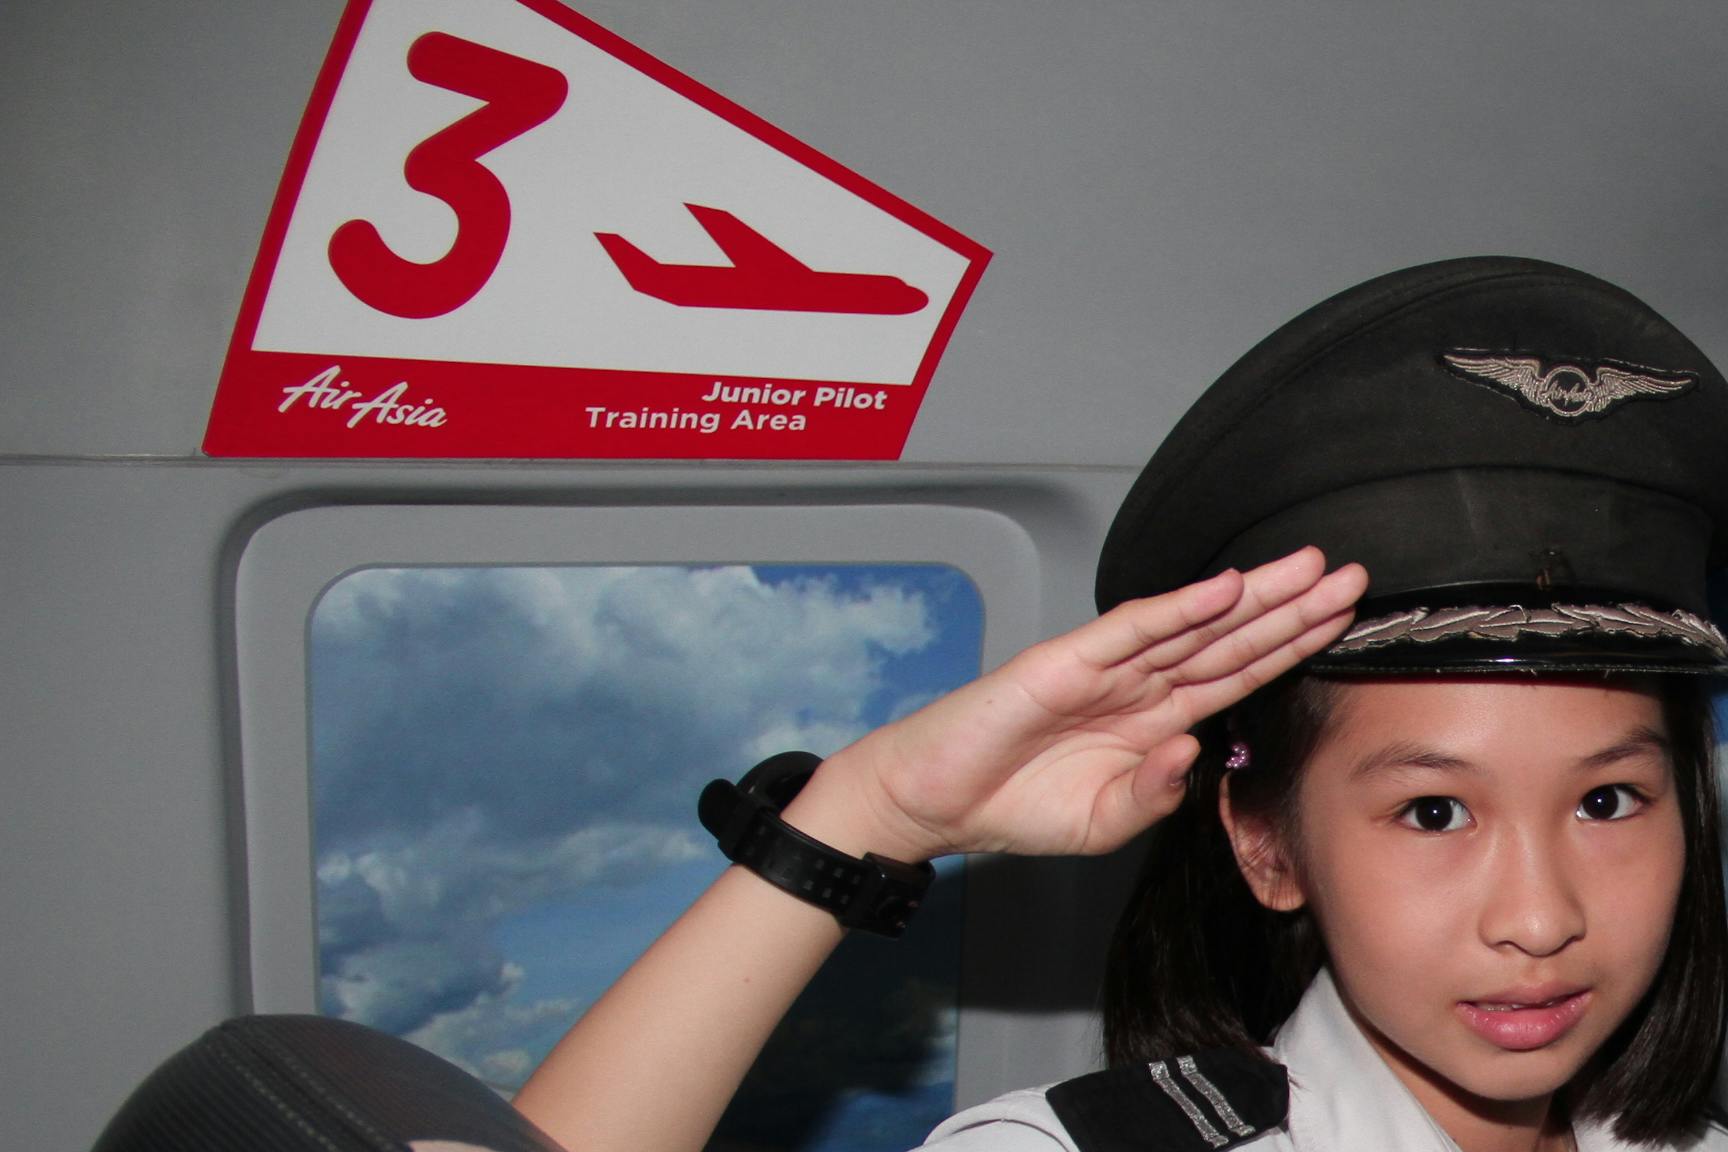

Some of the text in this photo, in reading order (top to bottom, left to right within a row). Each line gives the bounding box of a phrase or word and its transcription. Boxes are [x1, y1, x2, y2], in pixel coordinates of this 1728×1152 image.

[328, 31, 568, 319] 3
[701, 380, 888, 410] Junior Pilot
[584, 406, 808, 434] Training Area
